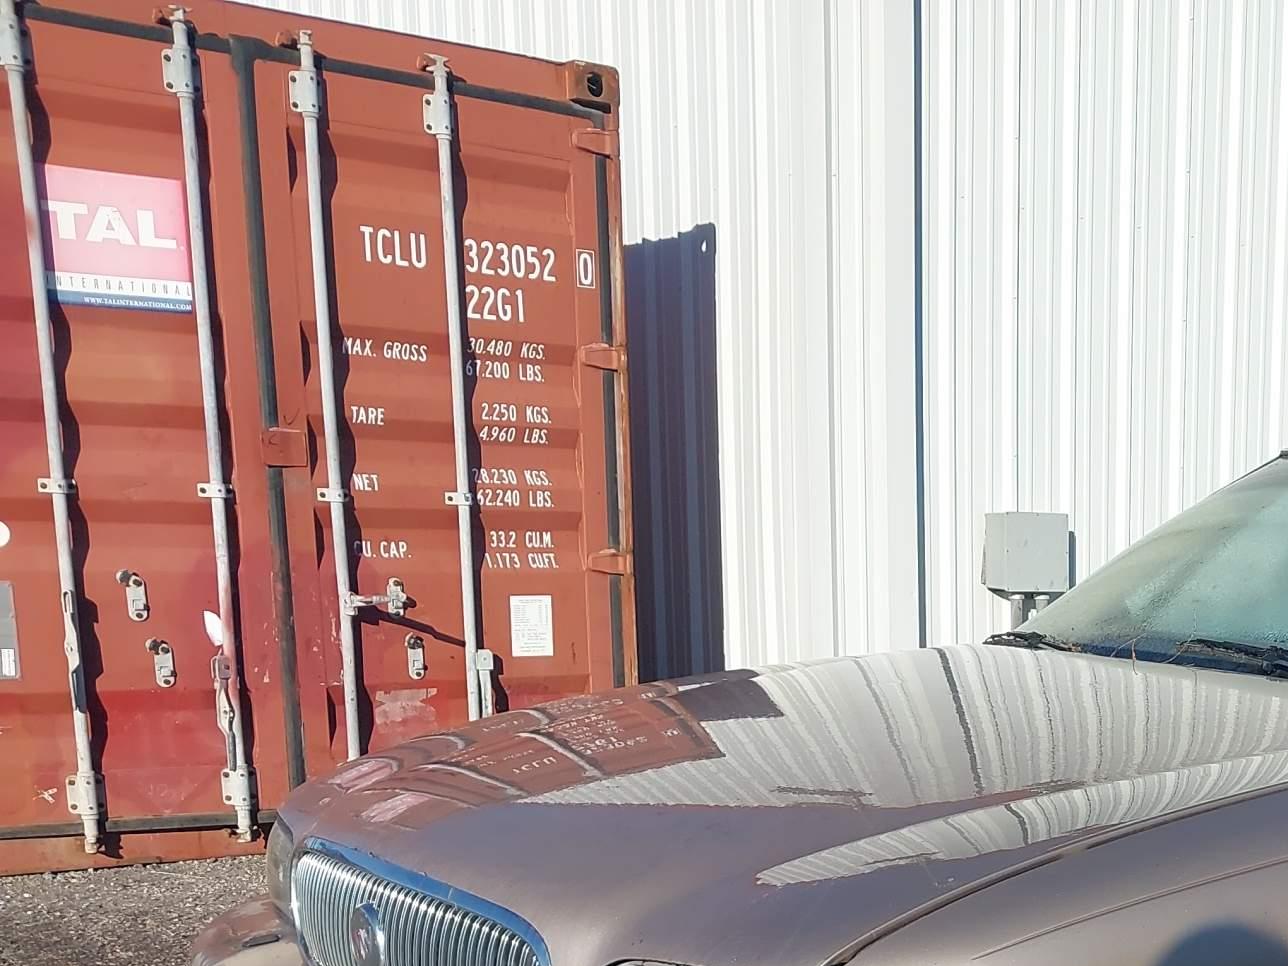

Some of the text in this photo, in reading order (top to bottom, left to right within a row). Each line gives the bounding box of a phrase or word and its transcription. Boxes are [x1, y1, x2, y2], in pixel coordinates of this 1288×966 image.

[42, 200, 177, 249] TAL
[359, 225, 594, 286] TCLU 323052 0
[46, 275, 191, 297] INTERNATIONAL
[465, 284, 525, 323] 22G1
[342, 337, 546, 362] MAX. GROSS 30.480 KGS.
[466, 360, 545, 382] 67.200 LBS.
[351, 403, 552, 426] TARE 2.250 KGS.
[479, 425, 549, 445] 4.960 LBS.
[353, 473, 378, 491] NET
[524, 469, 552, 486] KGS.
[476, 489, 555, 508] 62.240 LBS.
[380, 540, 412, 558] CAP.
[490, 530, 517, 549] 33.2
